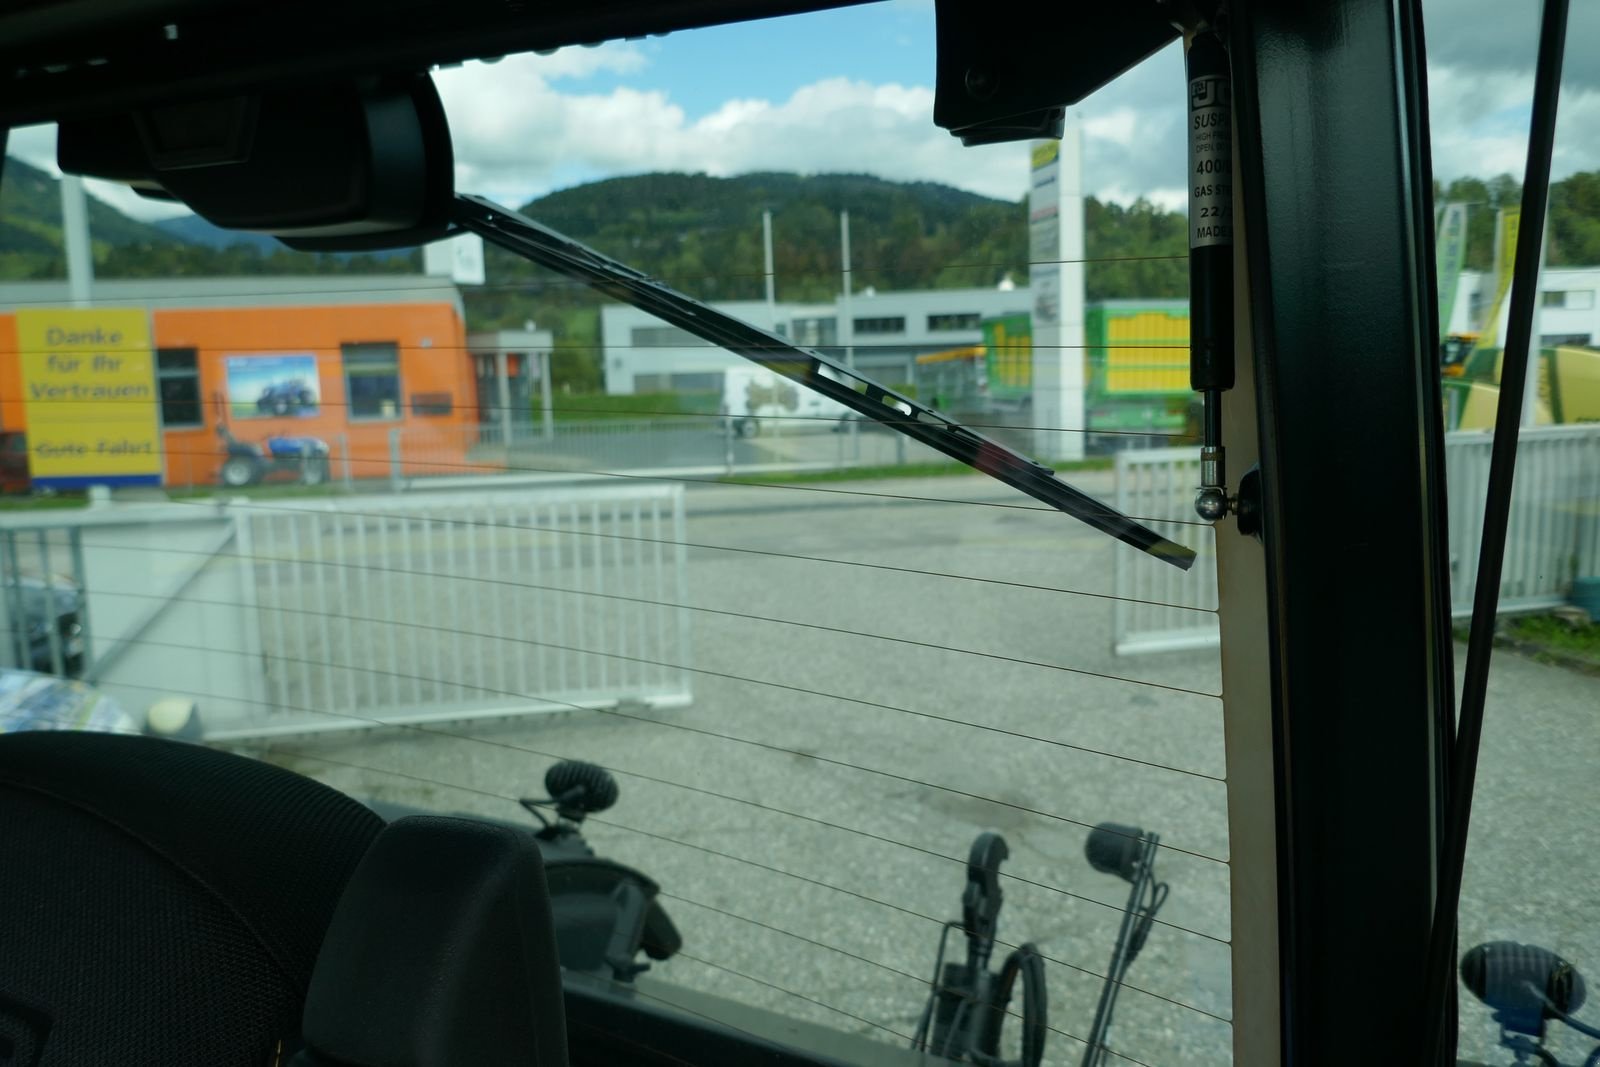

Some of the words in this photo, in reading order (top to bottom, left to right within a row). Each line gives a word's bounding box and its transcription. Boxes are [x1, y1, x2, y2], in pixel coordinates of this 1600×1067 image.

[1194, 111, 1230, 130] SUSP
[1194, 184, 1212, 198] GAS
[1197, 225, 1226, 239] MADE
[47, 327, 122, 346] Danke
[47, 355, 80, 372] für
[92, 354, 121, 371] Ihr
[31, 382, 149, 400] Vertrauen
[36, 444, 86, 458] Gute
[96, 439, 152, 455] Fahrt
